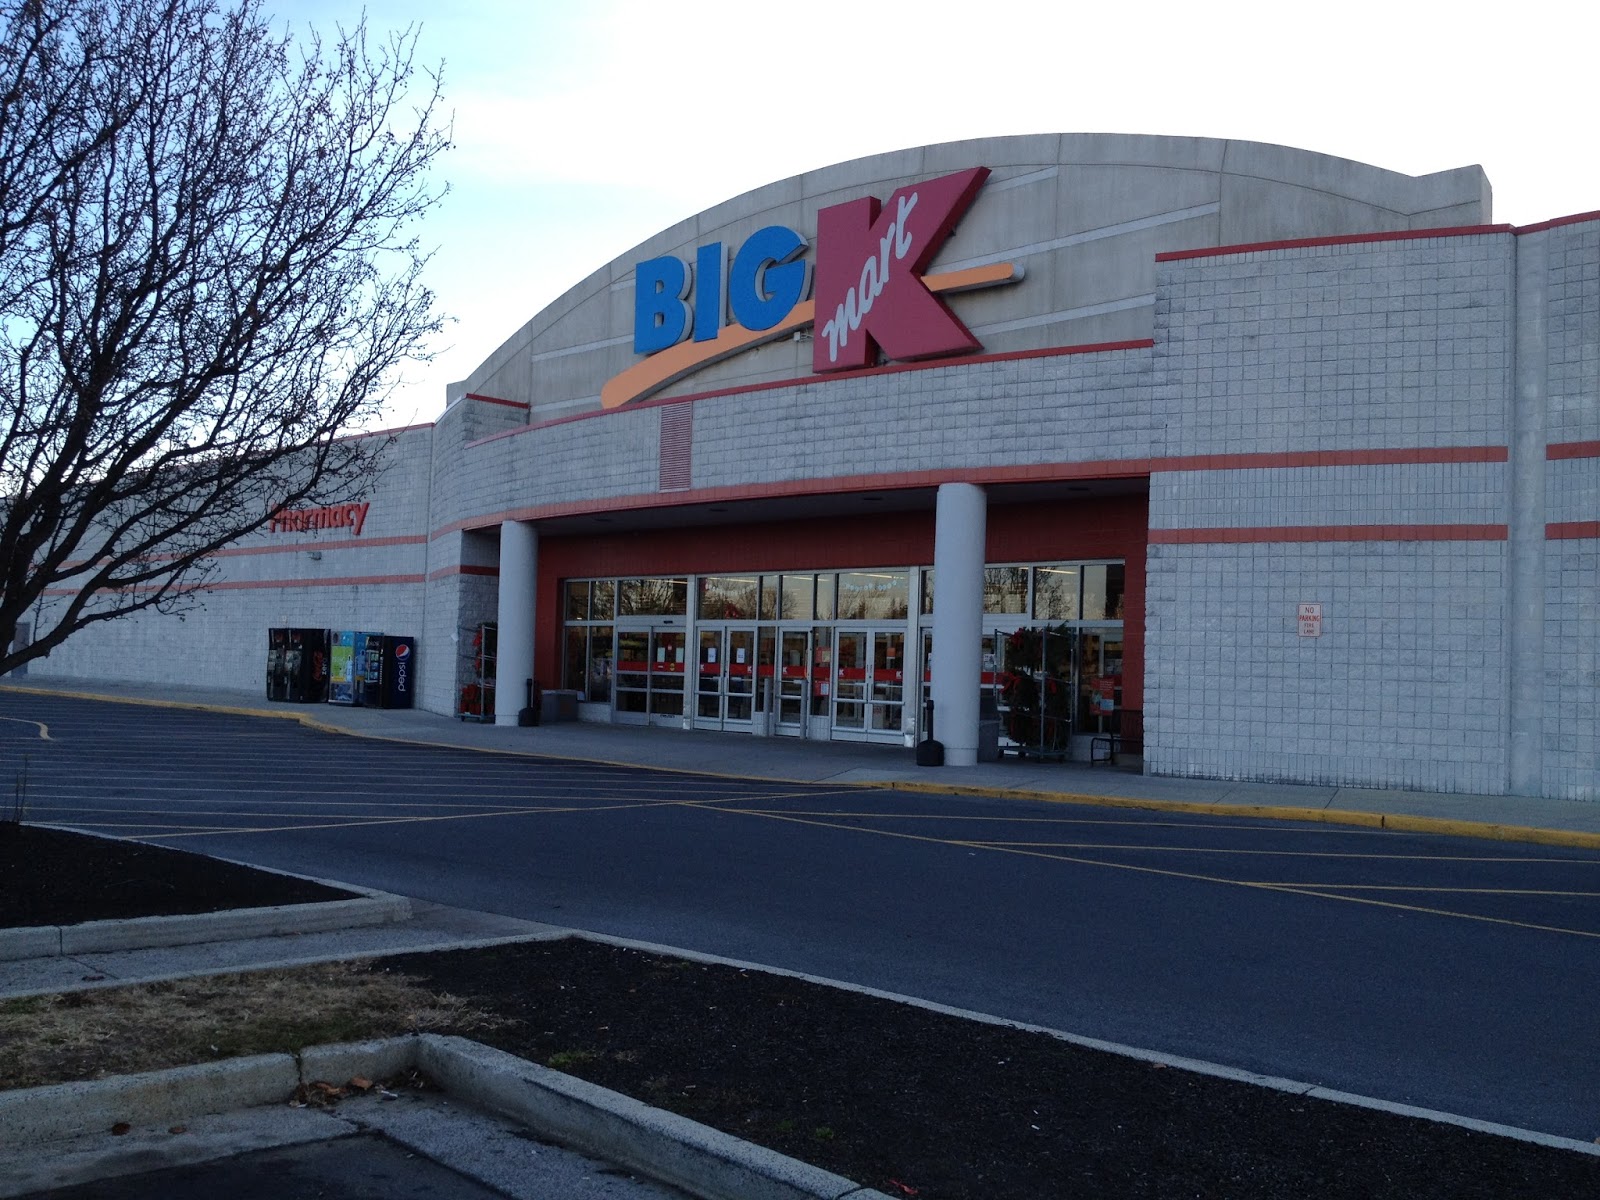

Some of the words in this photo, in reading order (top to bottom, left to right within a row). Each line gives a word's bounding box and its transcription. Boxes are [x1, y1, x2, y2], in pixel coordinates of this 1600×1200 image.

[634, 225, 809, 355] BIG
[813, 166, 992, 374] K
[821, 191, 919, 362] mart
[269, 502, 370, 536] Pharmacy
[1304, 606, 1315, 614] NO
[397, 661, 406, 692] pepsi
